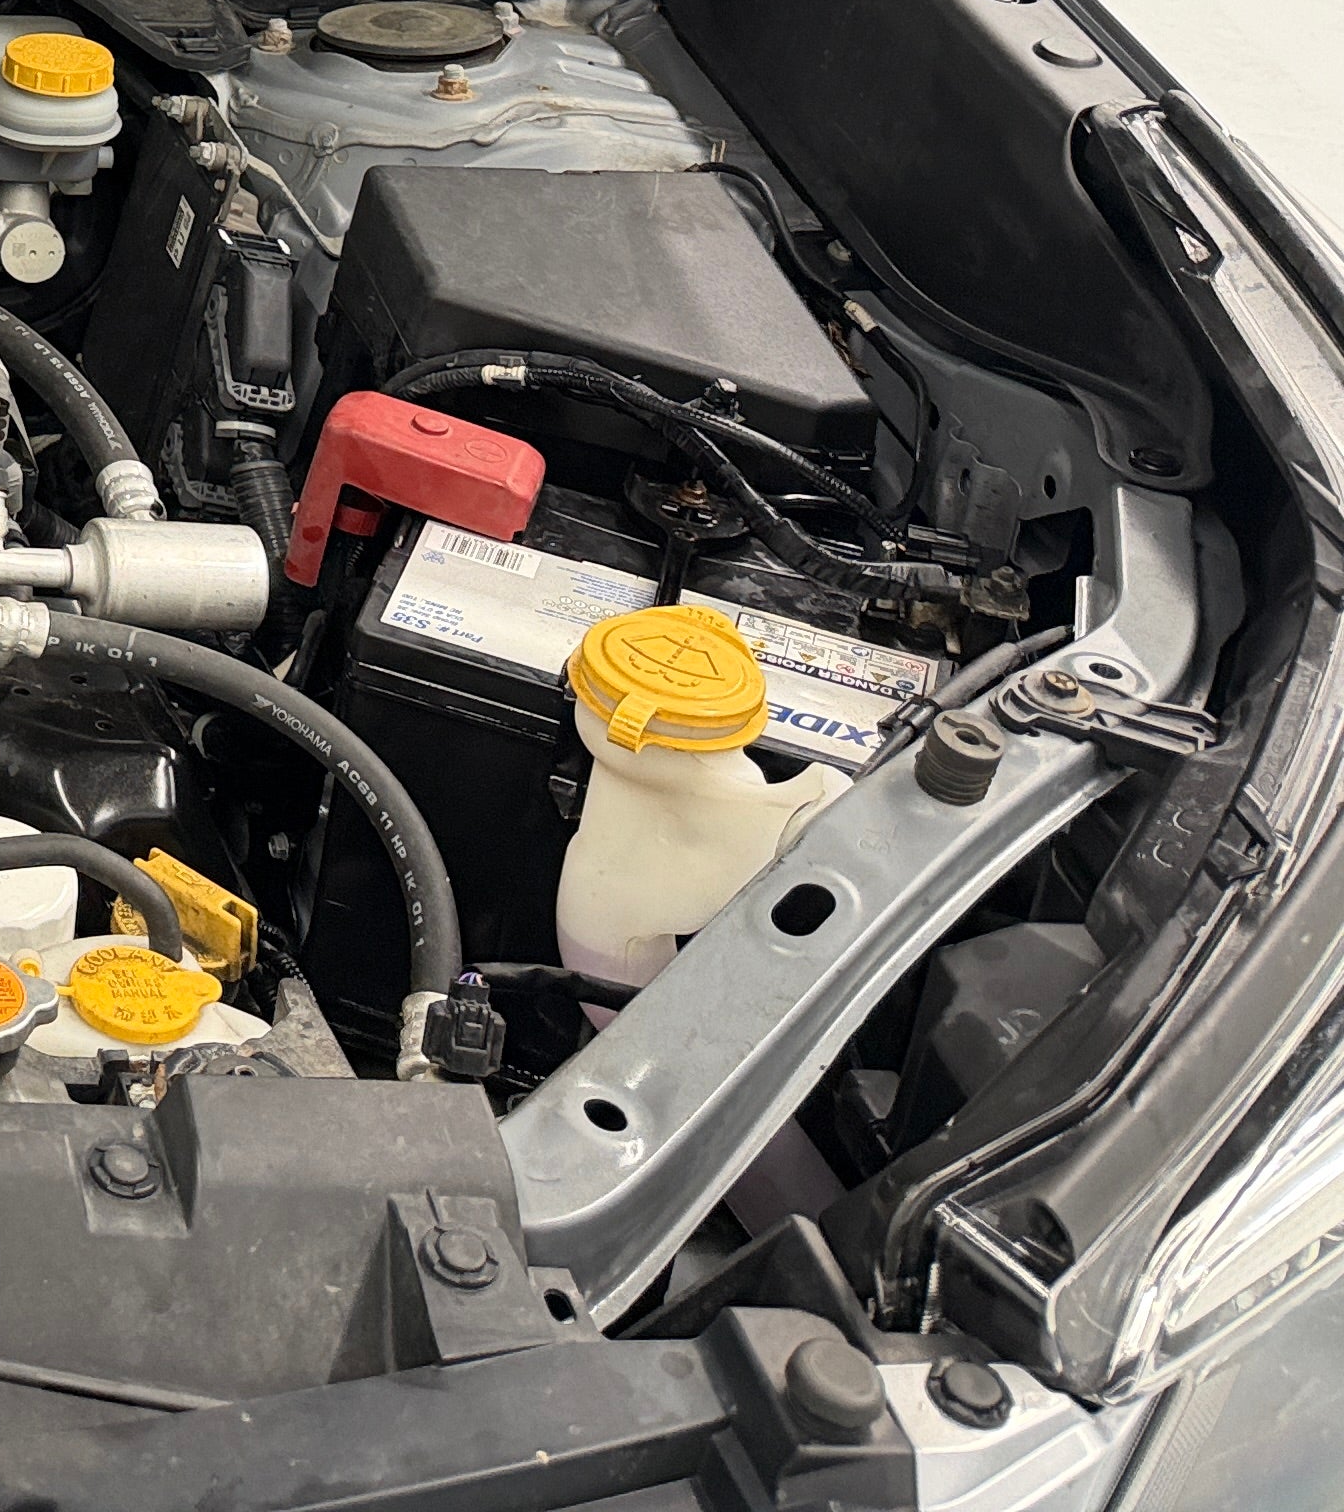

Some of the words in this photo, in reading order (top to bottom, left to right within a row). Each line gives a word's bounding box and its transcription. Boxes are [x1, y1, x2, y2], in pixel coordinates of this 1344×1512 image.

[390, 611, 432, 629] S35
[452, 628, 484, 644] Part
[752, 650, 808, 673] POISO
[818, 668, 894, 697] DANGER
[766, 701, 880, 749] XIDE
[270, 704, 334, 758] YOKOHAMA
[378, 809, 395, 832] 11
[390, 832, 408, 860] HP
[111, 987, 169, 1000] MANUAL
